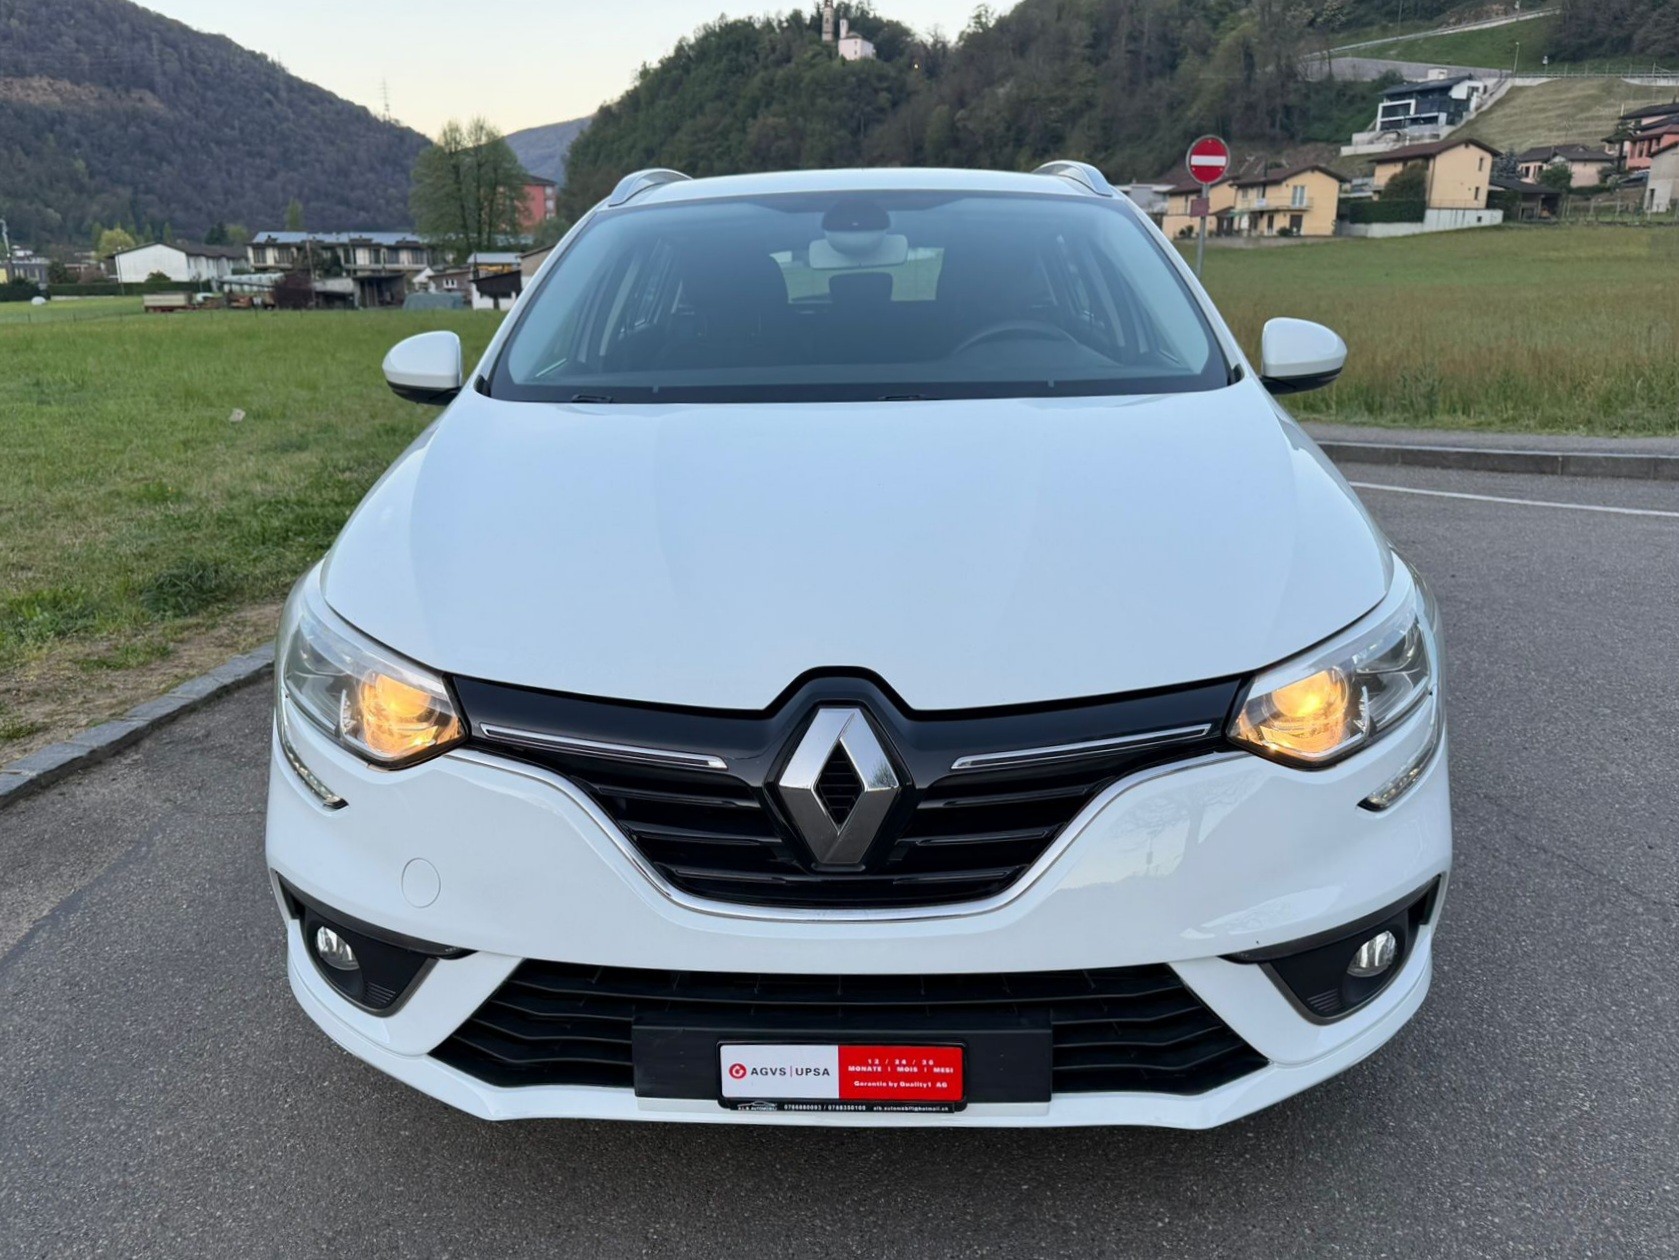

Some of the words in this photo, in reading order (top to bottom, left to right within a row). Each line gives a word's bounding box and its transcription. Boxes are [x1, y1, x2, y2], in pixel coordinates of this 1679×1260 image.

[750, 1067, 787, 1076] AGVS
[795, 1067, 830, 1077] UPSA
[888, 1080, 898, 1088] by
